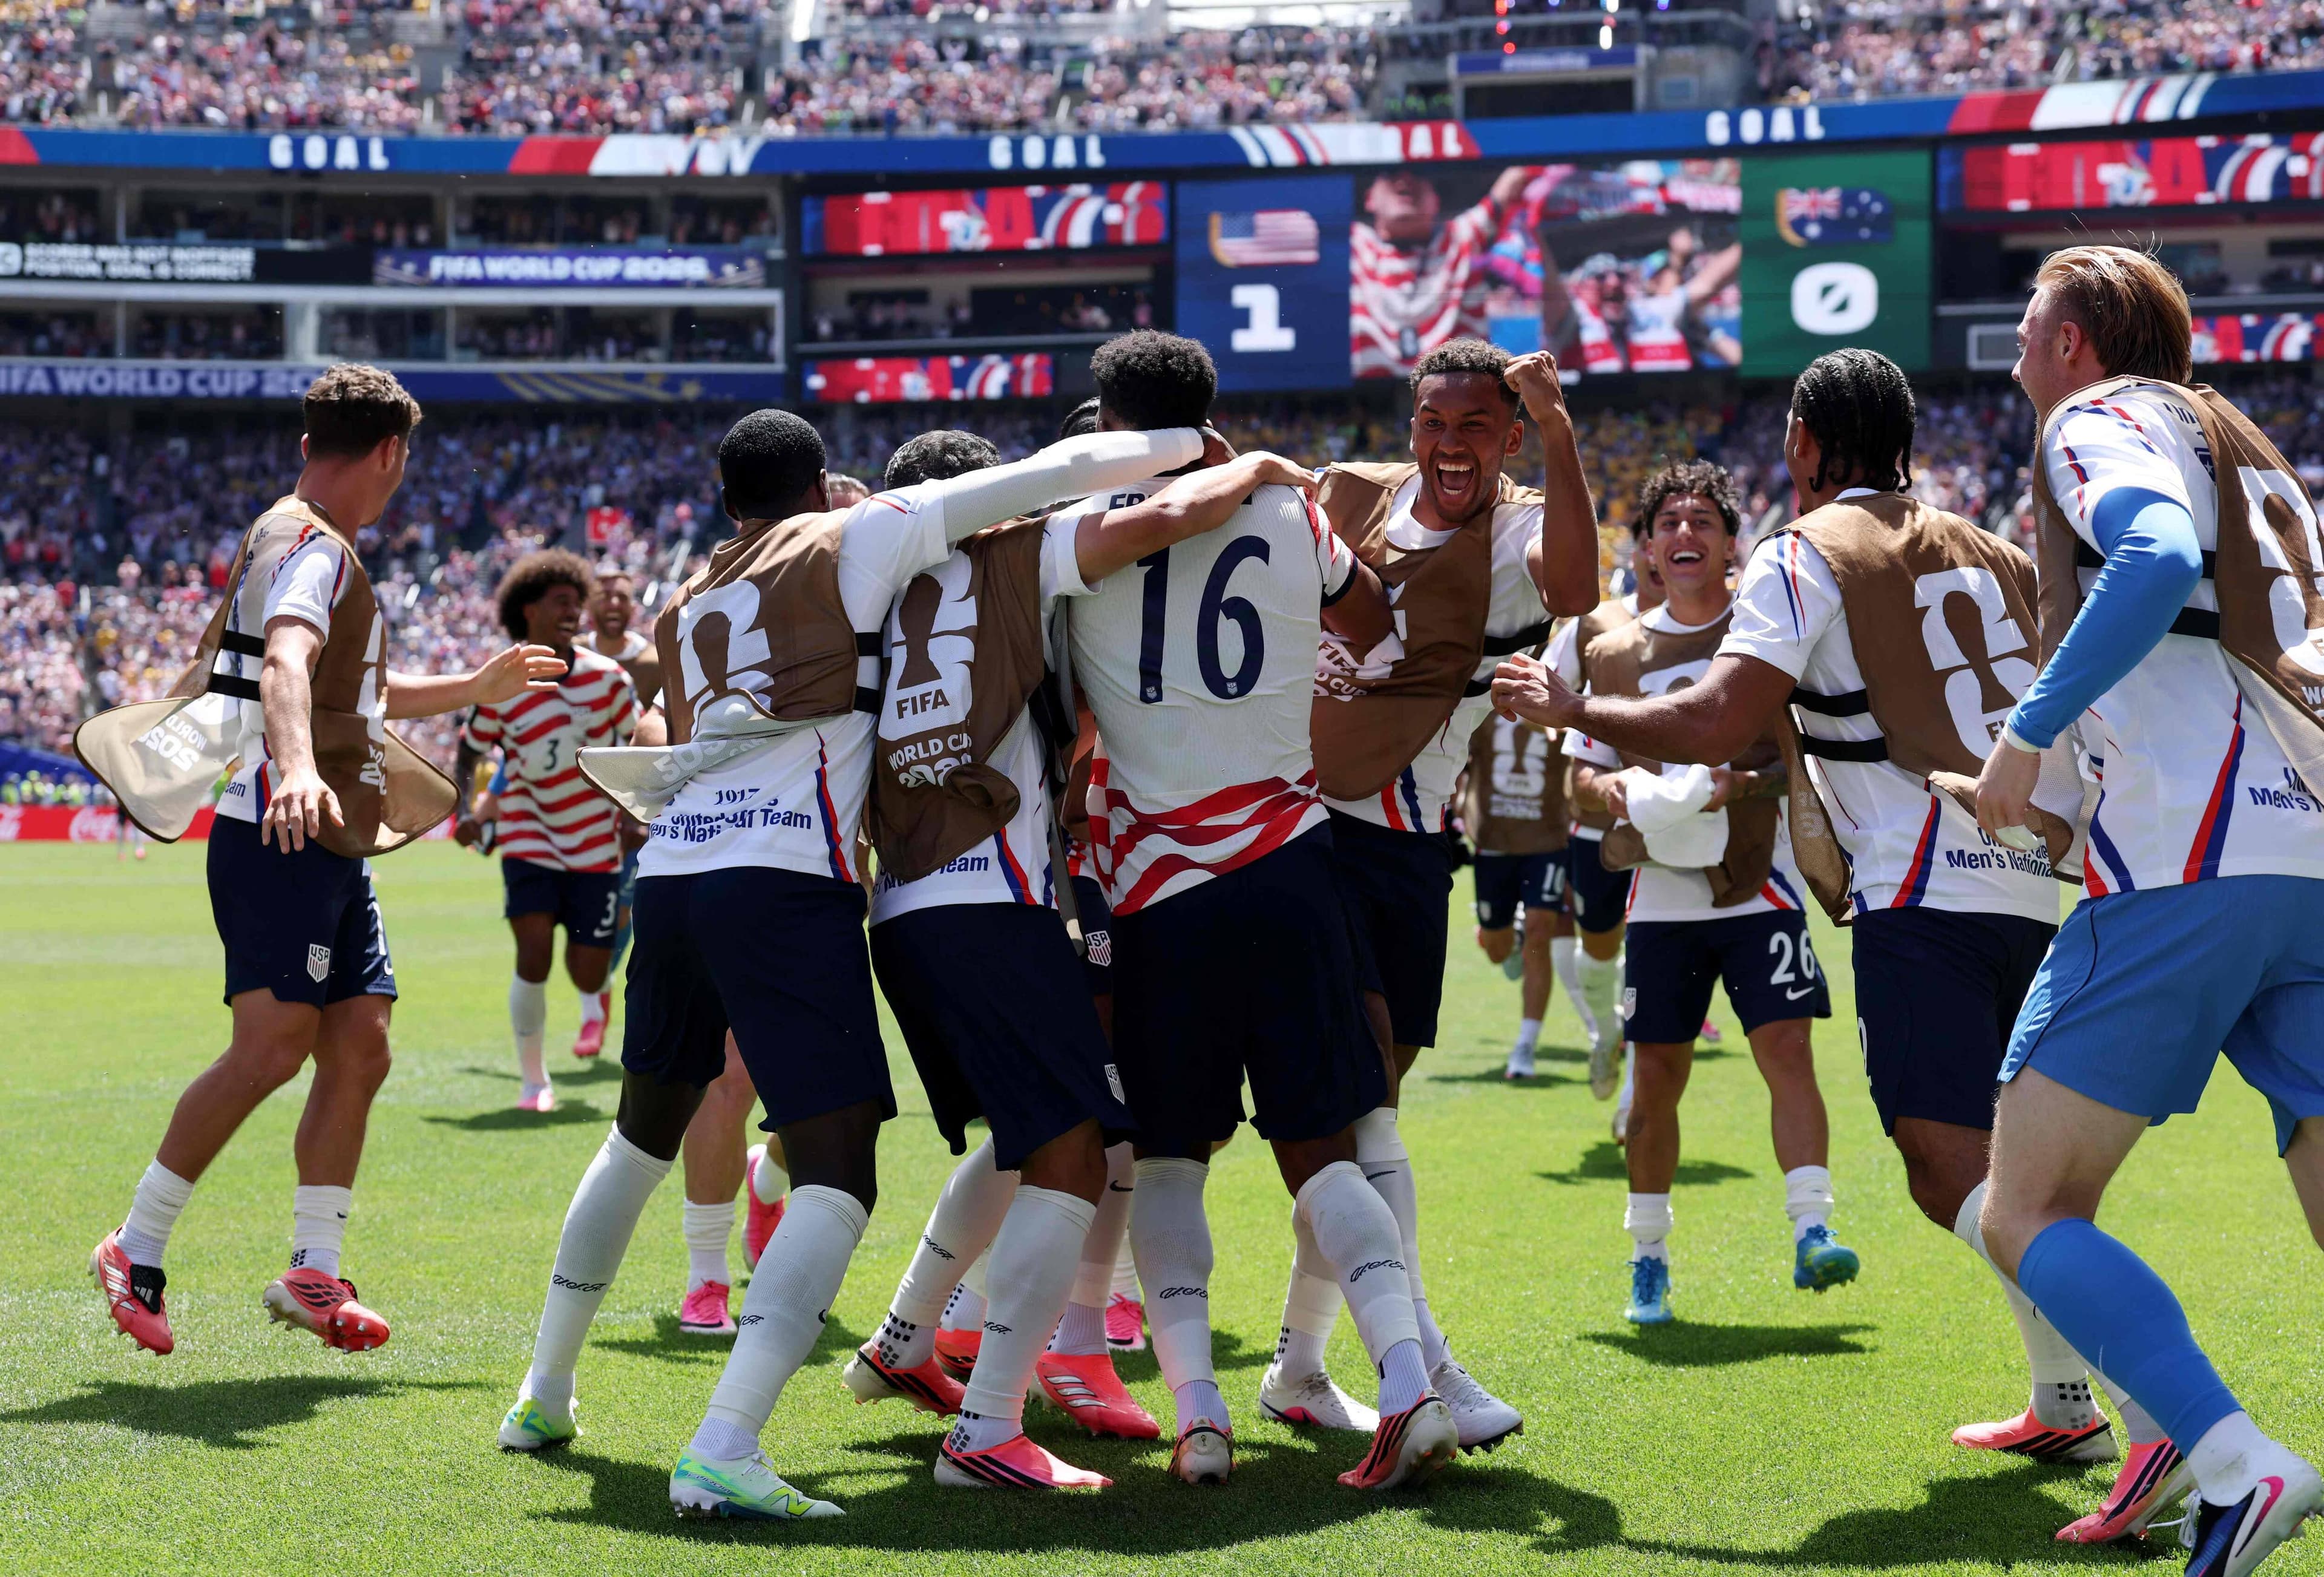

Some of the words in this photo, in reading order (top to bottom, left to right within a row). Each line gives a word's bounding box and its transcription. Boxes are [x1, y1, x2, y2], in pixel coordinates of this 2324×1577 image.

[1705, 105, 1825, 146] GOAL
[269, 134, 389, 171] GOAL
[989, 134, 1106, 169] GOAL
[429, 255, 484, 280] FIFA
[484, 256, 572, 280] WORLD
[573, 256, 622, 280] CUP
[623, 255, 709, 280] 2026
[1791, 261, 1878, 334] 0
[1231, 283, 1296, 352] 1
[0, 367, 52, 395] IFA
[54, 368, 182, 396] WORLD
[186, 369, 257, 396] CUP
[261, 370, 313, 396] 20
[1135, 535, 1270, 704] 16
[896, 689, 950, 720] FIFA
[543, 738, 560, 771] 3
[888, 738, 944, 772] WORLD
[2248, 787, 2310, 811] Men's
[760, 808, 812, 830] Team
[1946, 848, 2006, 869] Men's
[2006, 850, 2053, 877] Nationa
[600, 891, 618, 927] 3
[310, 945, 329, 962] USA
[1768, 929, 1816, 985] 26
[553, 1274, 607, 1292] U.S.A.
